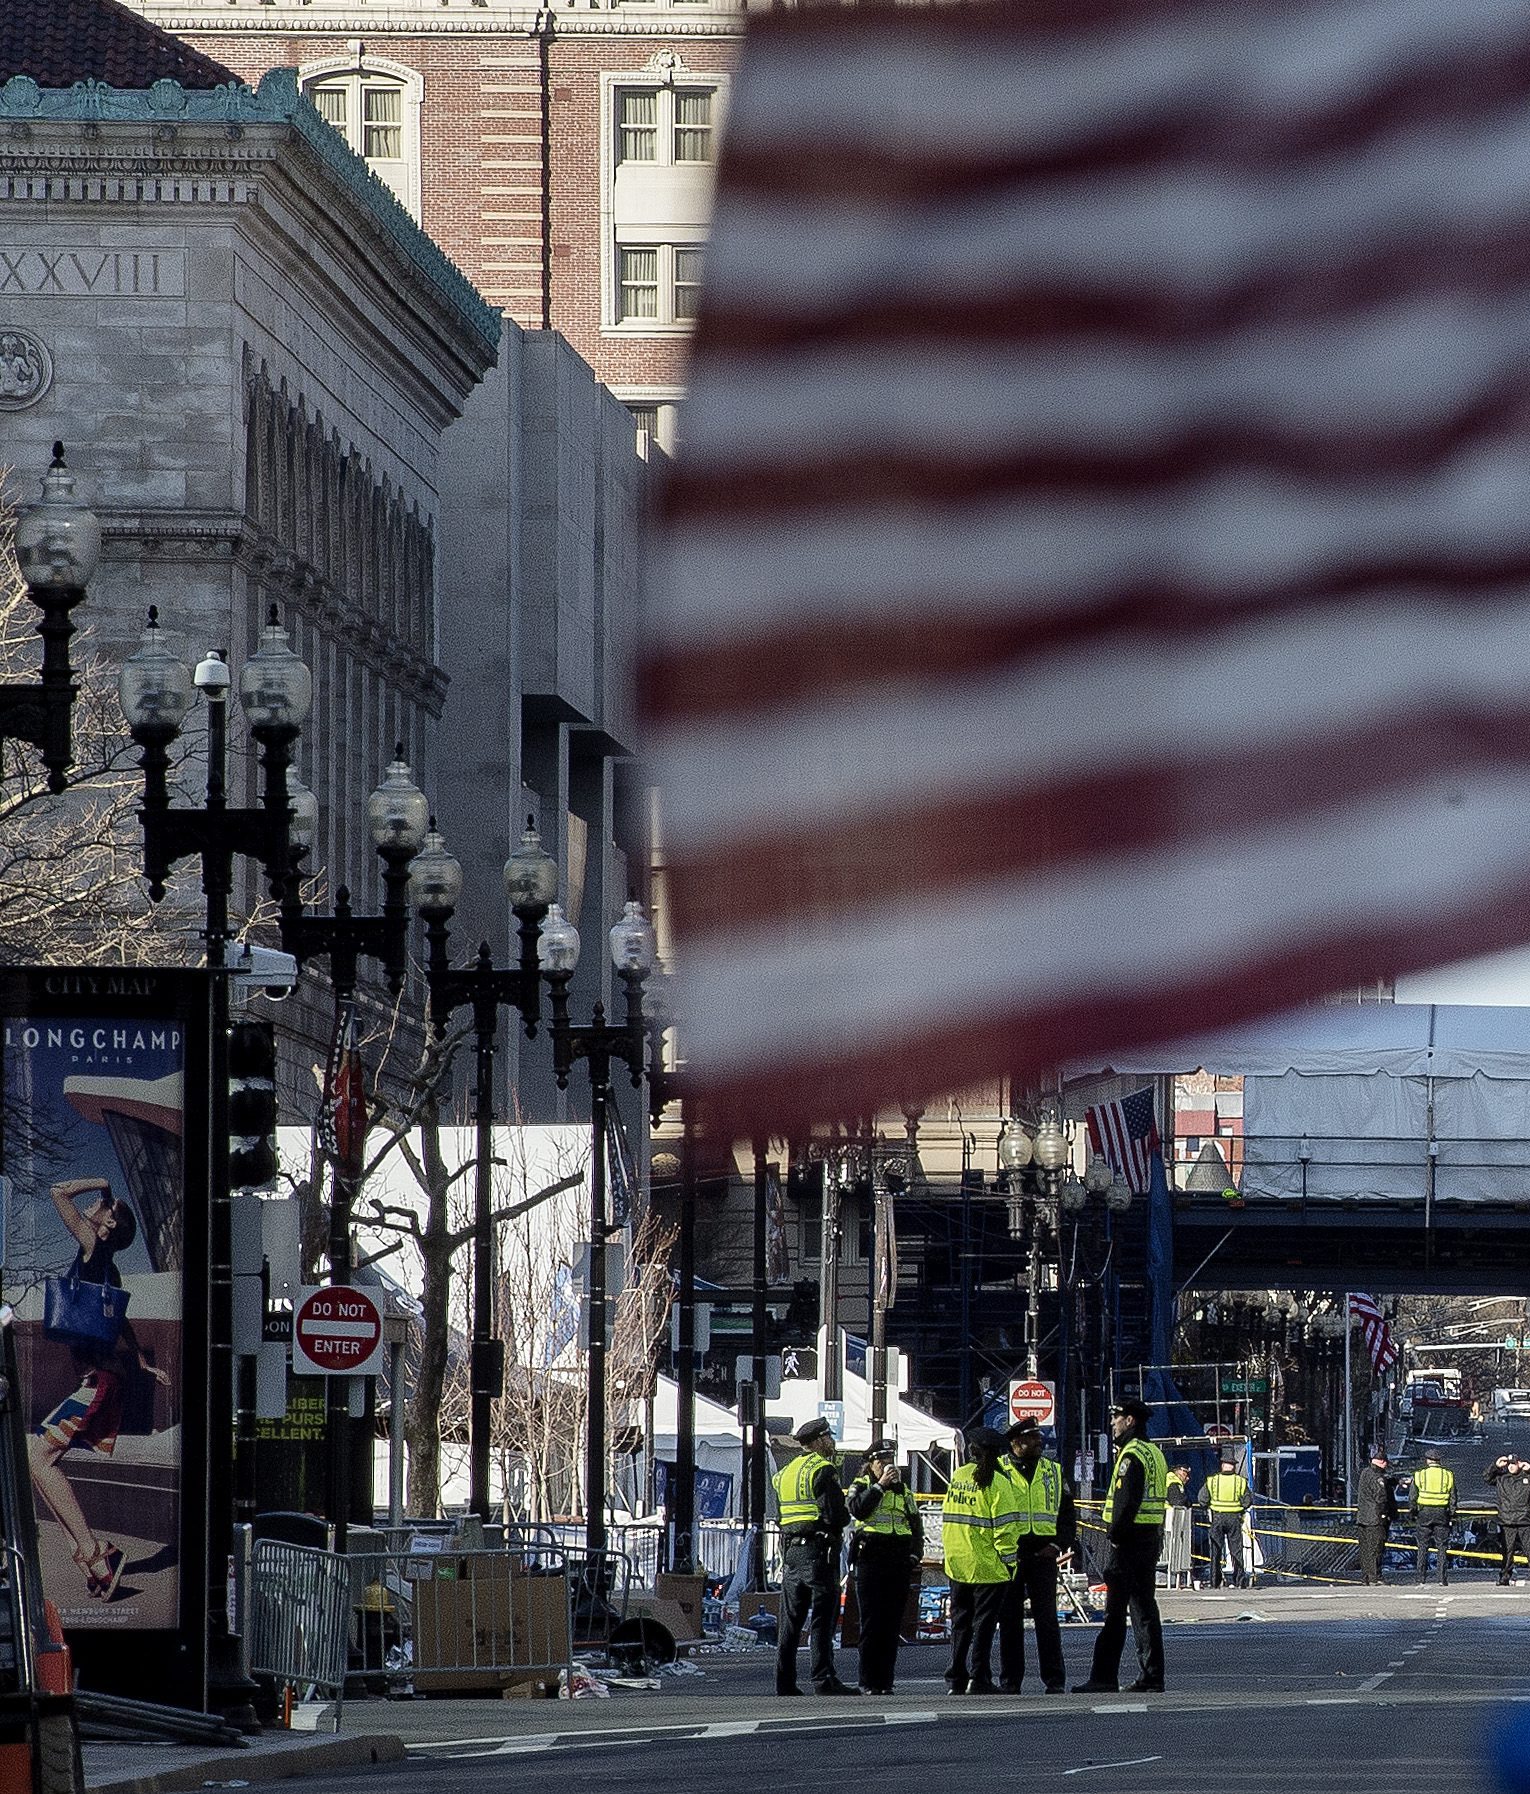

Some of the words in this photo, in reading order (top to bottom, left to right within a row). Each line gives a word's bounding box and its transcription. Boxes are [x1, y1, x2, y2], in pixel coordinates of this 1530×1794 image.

[45, 976, 98, 994] CITY
[107, 977, 157, 995] MAP
[5, 1027, 180, 1050] LONGCHAMP
[72, 1055, 133, 1064] PARIS
[312, 1302, 332, 1315] DO
[338, 1304, 367, 1317] NOT
[265, 1321, 290, 1333] ON
[314, 1340, 360, 1354] ENTER
[947, 1491, 977, 1506] Police
